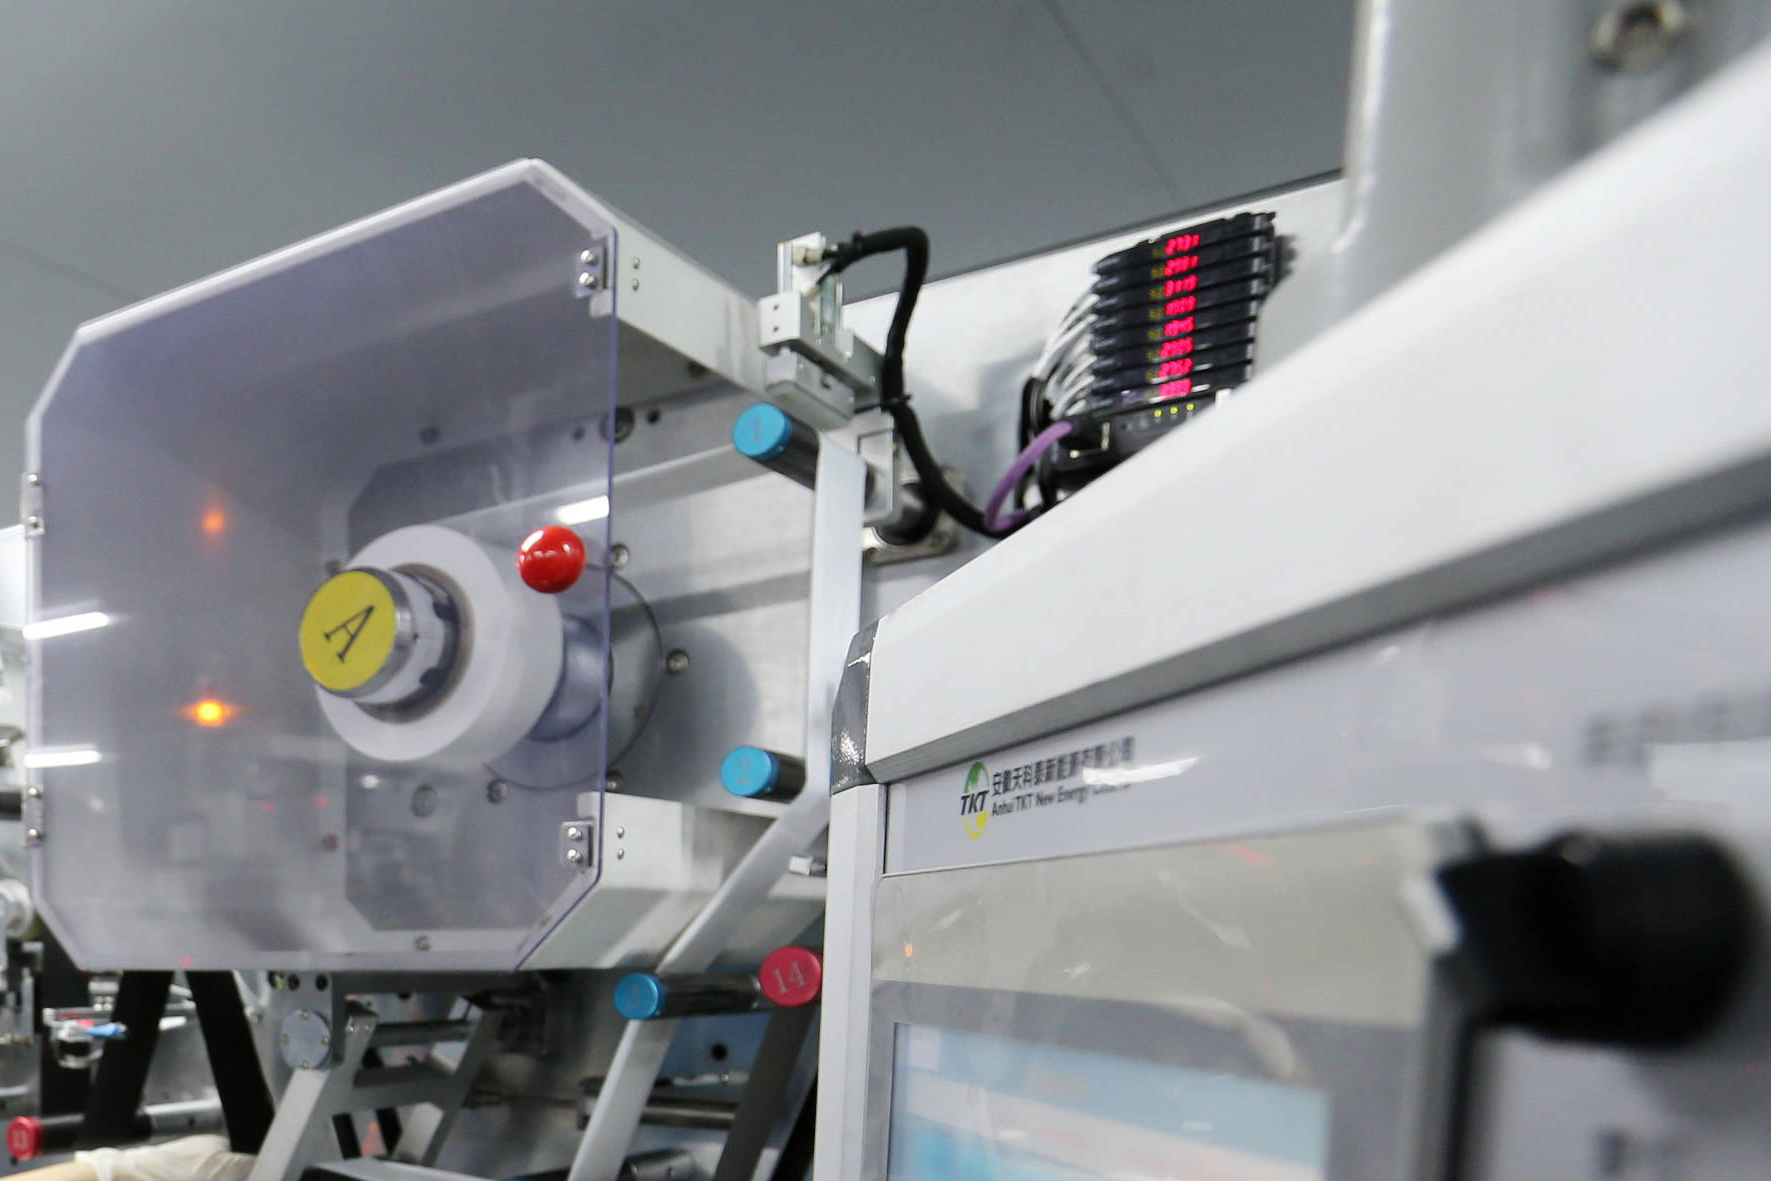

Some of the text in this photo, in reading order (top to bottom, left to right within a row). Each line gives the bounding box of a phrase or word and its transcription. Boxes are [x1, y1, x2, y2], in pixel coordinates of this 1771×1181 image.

[324, 604, 376, 665] A
[736, 757, 753, 785] 2
[960, 790, 991, 816] TKT
[991, 800, 1013, 817] Anhui
[1015, 793, 1033, 812] TKT
[1036, 790, 1055, 807] New
[773, 960, 806, 994] 14
